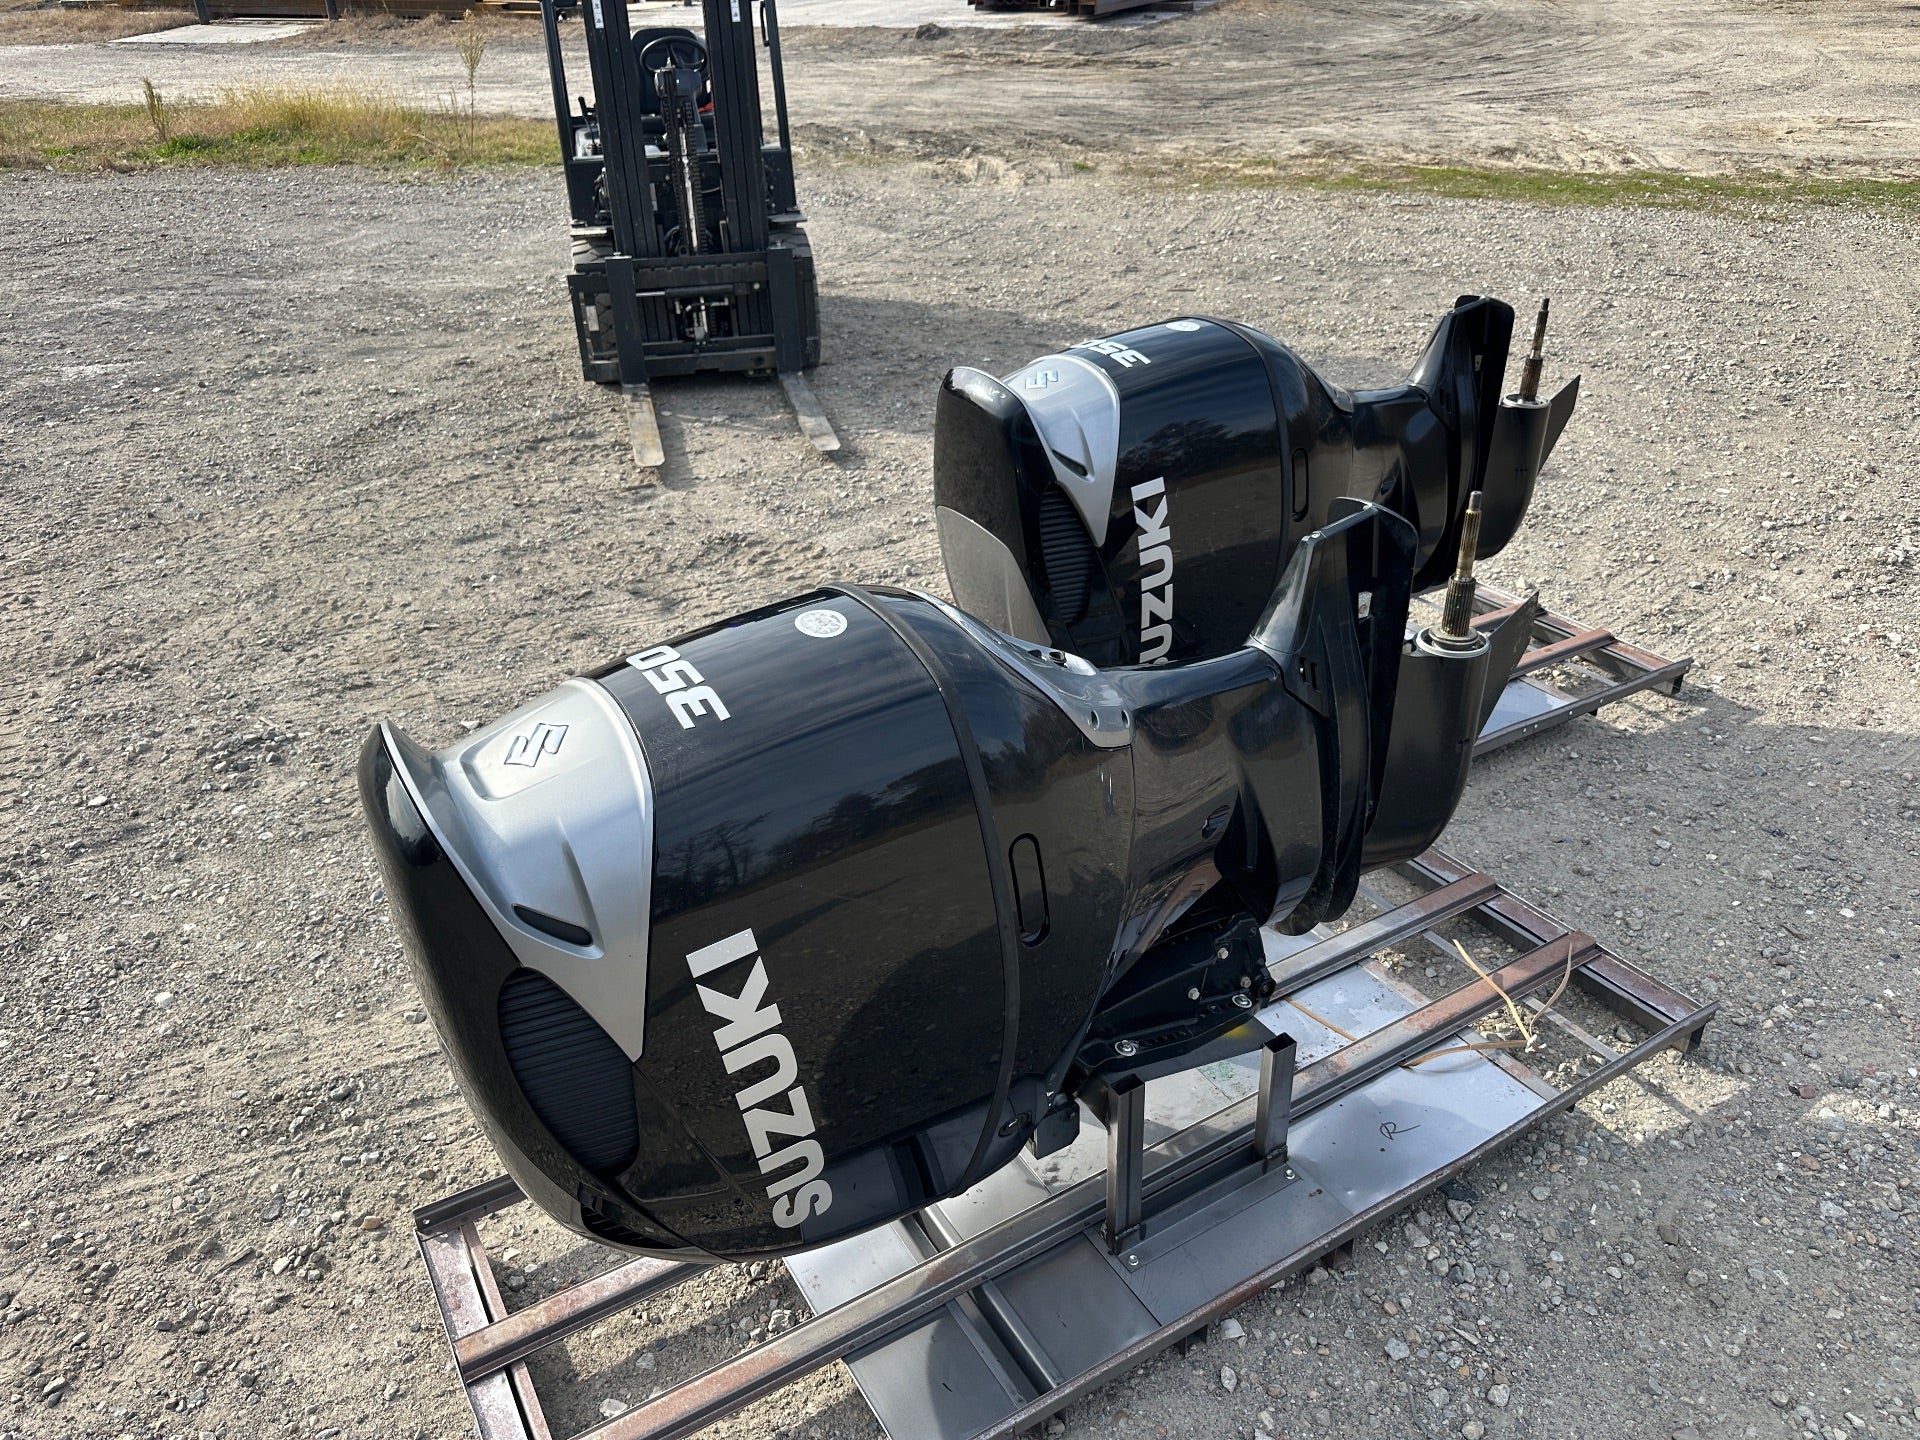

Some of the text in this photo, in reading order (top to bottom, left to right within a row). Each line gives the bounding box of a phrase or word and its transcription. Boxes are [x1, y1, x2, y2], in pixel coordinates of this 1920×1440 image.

[1131, 477, 1174, 665] UZUKI
[626, 645, 732, 730] 350
[686, 928, 833, 1229] SUZUKI
